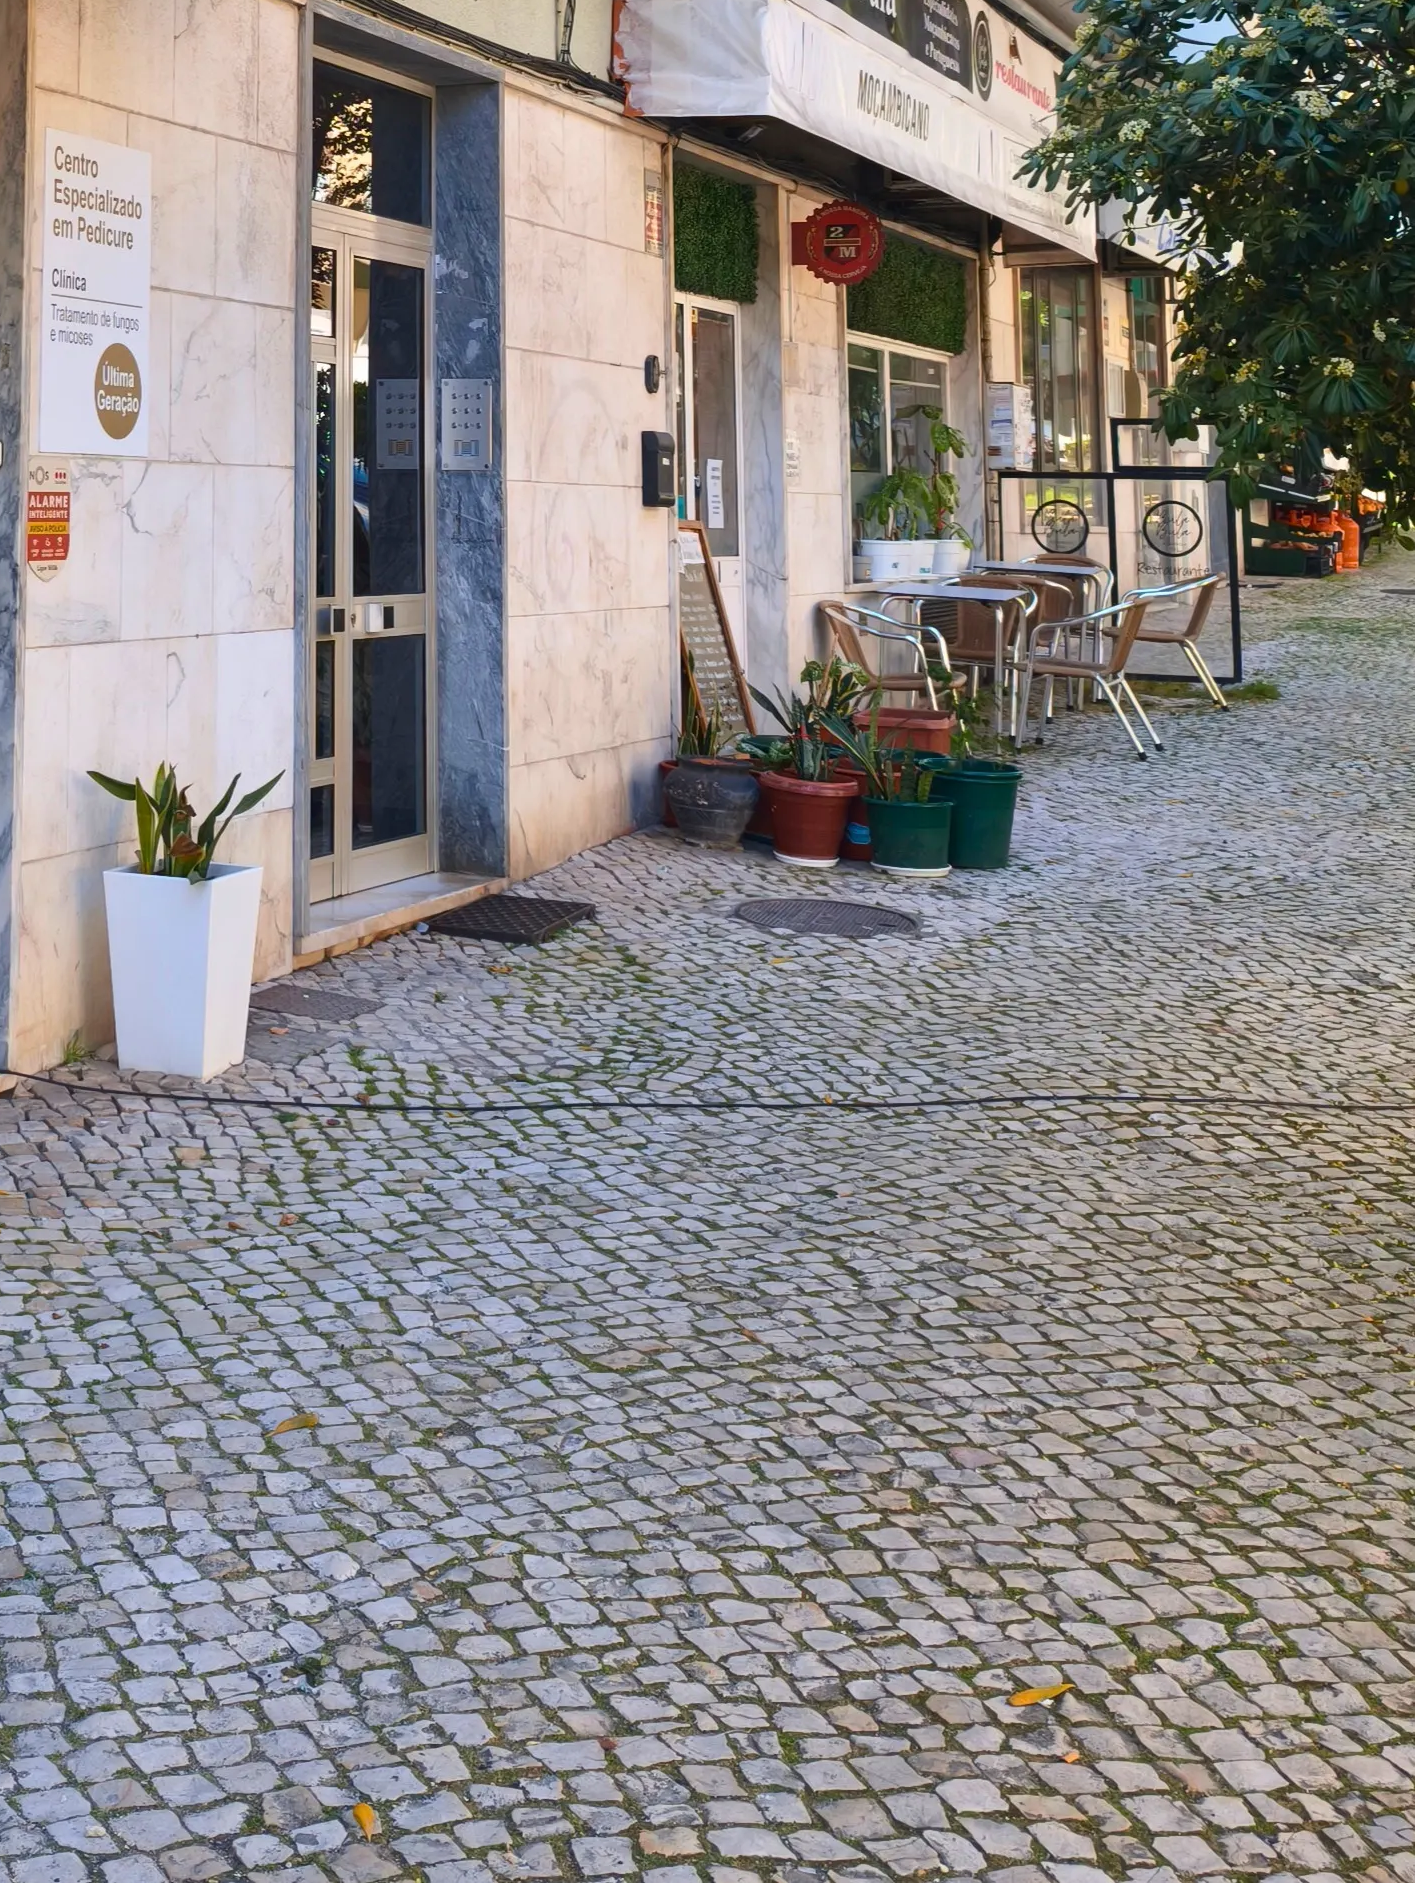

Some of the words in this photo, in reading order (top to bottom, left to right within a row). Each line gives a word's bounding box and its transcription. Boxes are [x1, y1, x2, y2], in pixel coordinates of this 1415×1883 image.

[995, 60, 1052, 113] restaurante
[857, 70, 929, 142] MOÇAMBICANO
[54, 145, 99, 178] Centro
[54, 179, 142, 220] Especializado
[53, 218, 73, 239] em
[78, 217, 134, 250] Pedicure
[829, 226, 845, 238] 2
[839, 246, 856, 258] M
[52, 268, 86, 291] Clínica
[51, 304, 99, 326] Tratamento
[100, 310, 111, 327] de
[113, 312, 140, 334] fungos
[50, 329, 57, 342] e
[58, 326, 94, 347] micoses
[102, 361, 135, 388] Última
[97, 390, 139, 417] Geração
[29, 466, 49, 485] NOS
[29, 495, 68, 508] ALARME
[29, 510, 68, 519] INTELIGENTE
[1137, 562, 1210, 578] Restaurante
